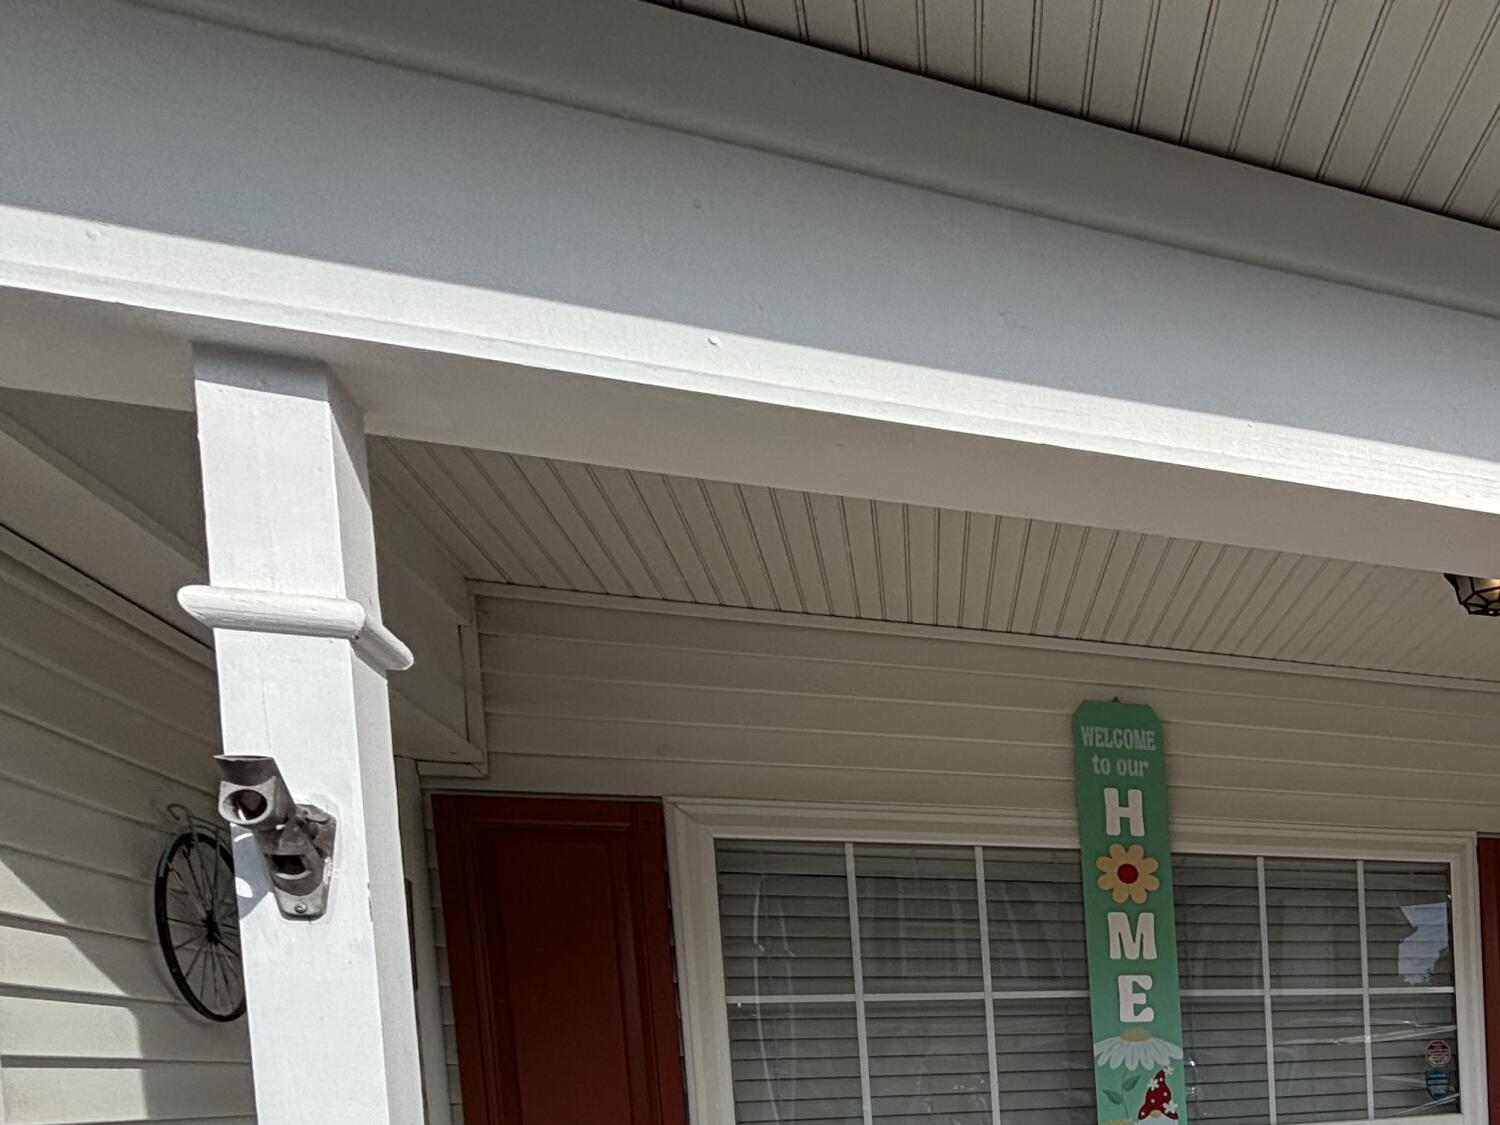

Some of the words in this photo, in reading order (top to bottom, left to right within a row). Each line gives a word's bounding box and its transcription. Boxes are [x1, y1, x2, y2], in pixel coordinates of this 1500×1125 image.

[1081, 725, 1156, 750] WELCOME
[1091, 753, 1111, 775] to
[1116, 757, 1149, 777] our
